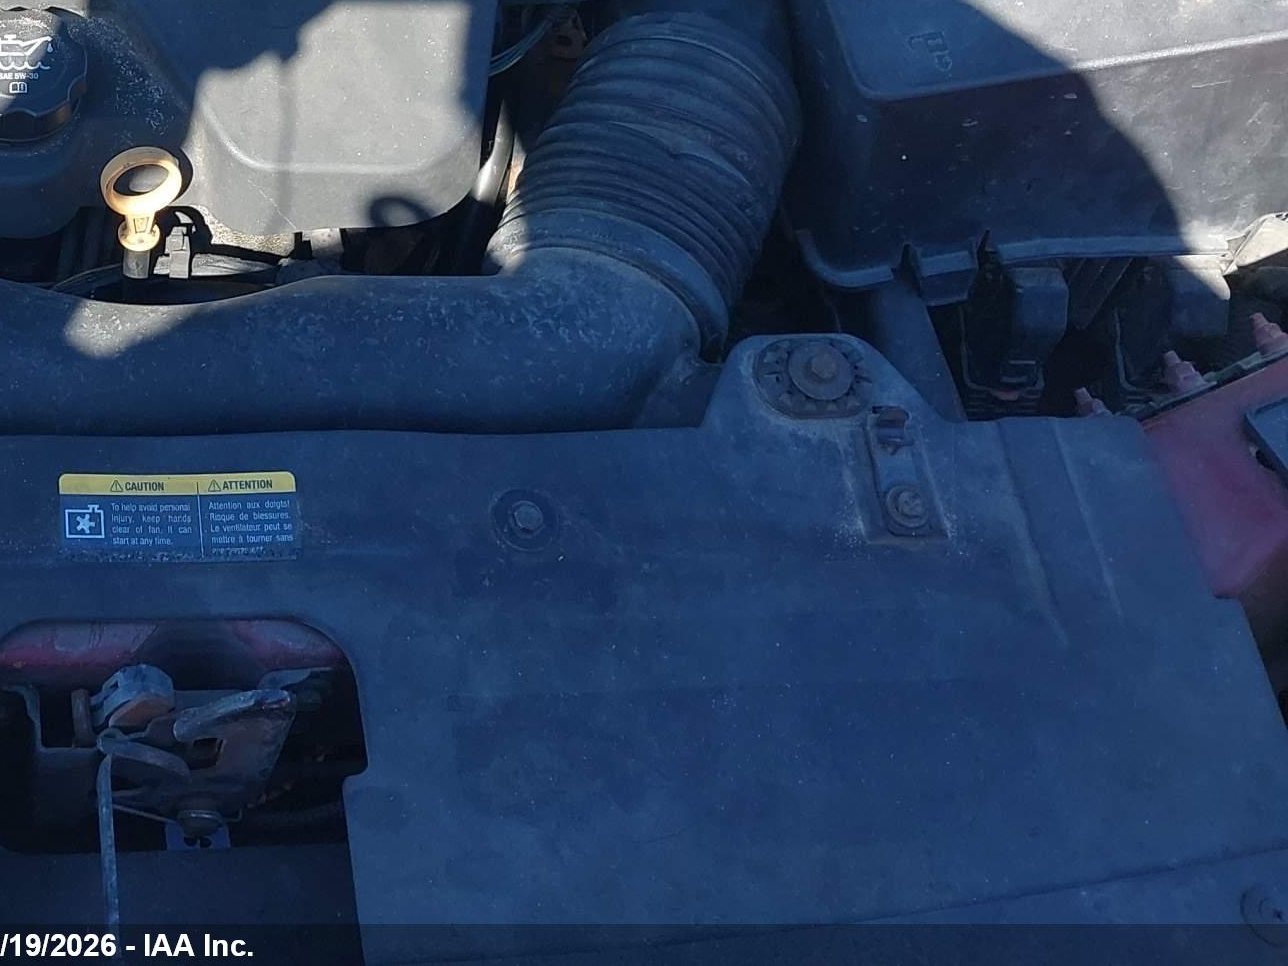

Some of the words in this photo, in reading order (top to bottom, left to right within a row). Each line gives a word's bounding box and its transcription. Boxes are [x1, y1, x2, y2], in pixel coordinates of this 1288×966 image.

[14, 72, 39, 80] 5W-30
[125, 482, 164, 491] CAUTION
[222, 480, 272, 490] ATTENTION
[112, 503, 119, 512] To
[122, 503, 136, 512] help
[160, 504, 191, 513] personal
[209, 502, 242, 510] Attention
[142, 515, 161, 524] keep
[168, 514, 192, 523] hands
[210, 513, 235, 522] Risque
[239, 512, 248, 520] de
[112, 526, 130, 534] clear
[136, 526, 142, 534] of
[210, 524, 219, 532] Le
[223, 524, 260, 532] ventilateur
[264, 522, 280, 532] peut
[113, 537, 129, 545] start
[131, 537, 138, 545] at
[140, 538, 152, 546] any
[246, 535, 272, 543] tourner
